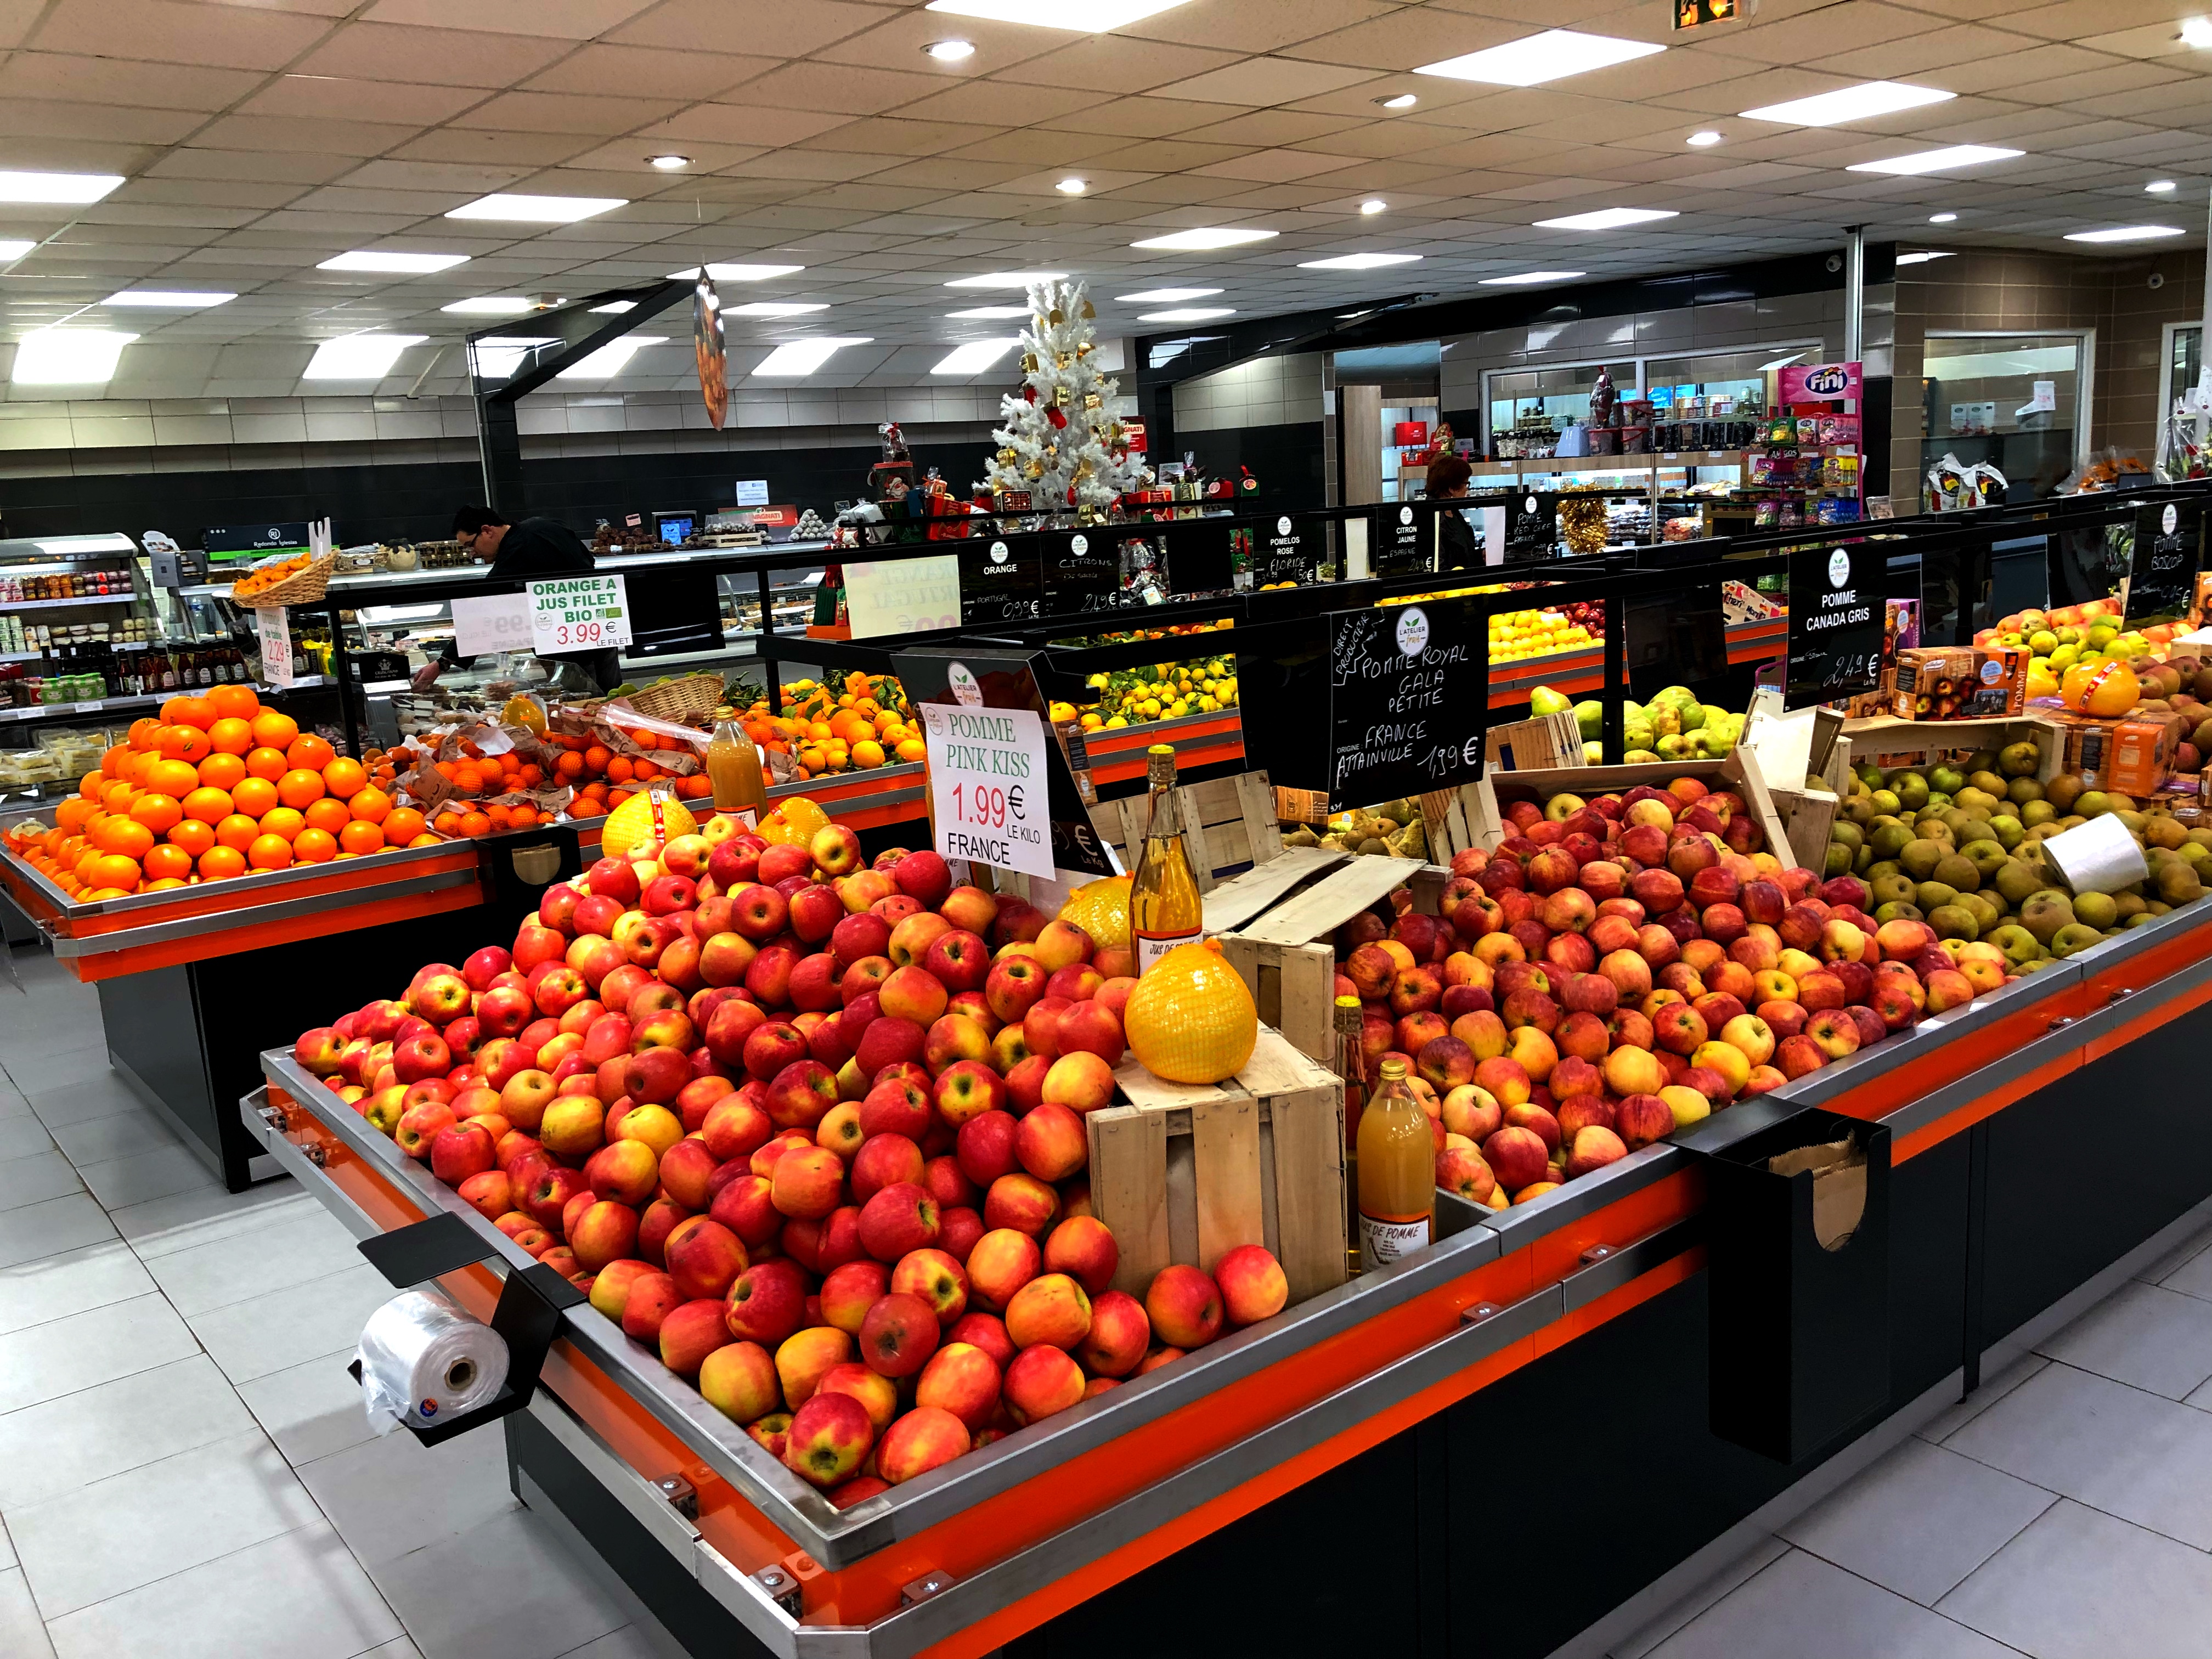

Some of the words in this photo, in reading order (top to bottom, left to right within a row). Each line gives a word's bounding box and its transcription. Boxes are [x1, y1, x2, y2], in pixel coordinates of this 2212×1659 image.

[1810, 369, 1843, 391] Fini
[1771, 450, 1797, 458] AMGOS
[1517, 512, 1542, 526] POMME
[1396, 526, 1417, 534] CITRON
[1514, 526, 1530, 535] RED
[1270, 536, 1300, 546] POMELOS
[1397, 535, 1416, 544] JAUNE
[1277, 547, 1294, 555] ROSE
[1390, 547, 1415, 557] ESPAGNE
[984, 564, 1017, 575] ORANGE
[1059, 558, 1112, 568] CITRONS
[1270, 556, 1307, 572] FLORIDE
[533, 579, 601, 596] ORANGE
[606, 578, 617, 590] A
[536, 597, 567, 611] JUS
[573, 592, 616, 607] FILET
[977, 594, 1011, 603] PORTUGAL
[1822, 590, 1857, 608] POMME
[564, 610, 592, 623] BIO
[1806, 612, 1846, 631] CANADA
[1848, 607, 1870, 623] GRIS
[556, 623, 601, 645] 3.99
[1333, 617, 1353, 656] DIRECT
[1399, 626, 1426, 635] L'ATELIER
[607, 637, 629, 646] FILET
[1406, 634, 1420, 647] frais
[1362, 654, 1418, 679] POMME
[1422, 645, 1469, 667] ROYAL
[1398, 669, 1444, 695] GALA
[2013, 669, 2026, 708] POMME
[1389, 688, 1443, 713] PETITE
[947, 713, 1017, 743] POMME
[1365, 720, 1427, 749] FRANCE
[946, 744, 988, 772] PINK
[992, 749, 1030, 778] KISS
[1336, 743, 1413, 788] ATTAINVILLE
[952, 782, 1006, 828] 1.99
[1007, 825, 1018, 839] LE
[1020, 826, 1041, 844] KILO
[947, 832, 1011, 866] FRANCE
[1149, 944, 1164, 955] JUS
[1372, 1225, 1385, 1236] DE
[1385, 1225, 1420, 1239] POMME
